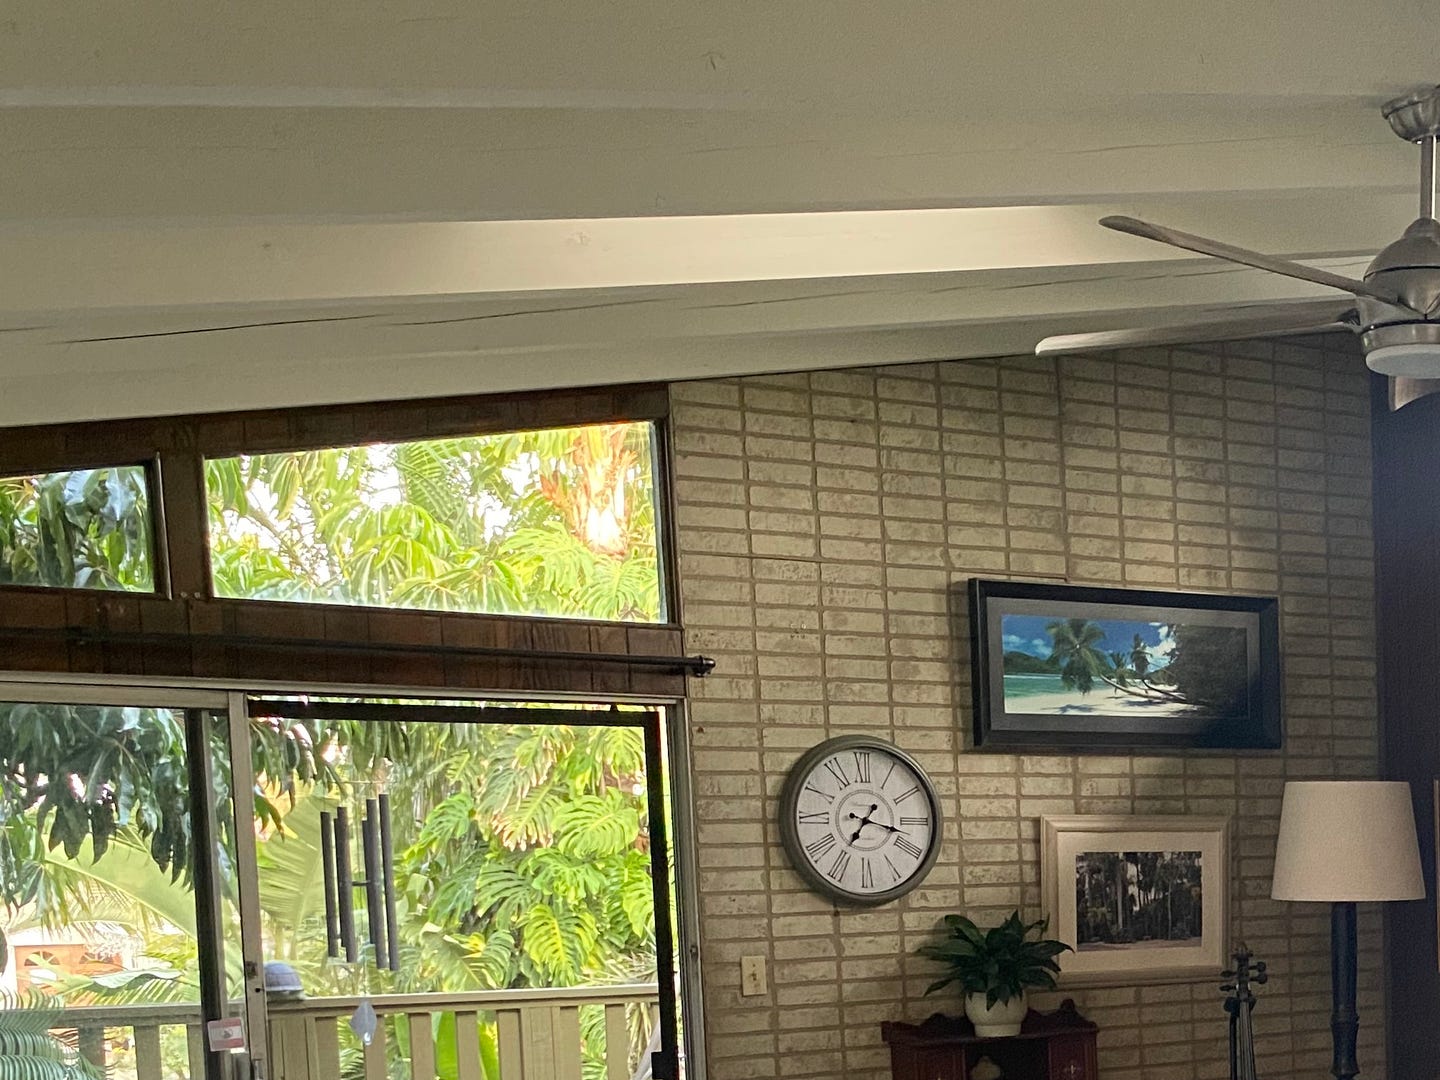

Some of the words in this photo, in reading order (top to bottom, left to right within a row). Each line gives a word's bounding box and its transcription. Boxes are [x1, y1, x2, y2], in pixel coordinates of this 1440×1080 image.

[824, 757, 851, 790] XI
[853, 752, 871, 783] XII
[894, 786, 919, 805] II
[799, 811, 829, 824] IX
[900, 817, 928, 825] III
[806, 833, 836, 863] VIII
[827, 849, 851, 882] VII
